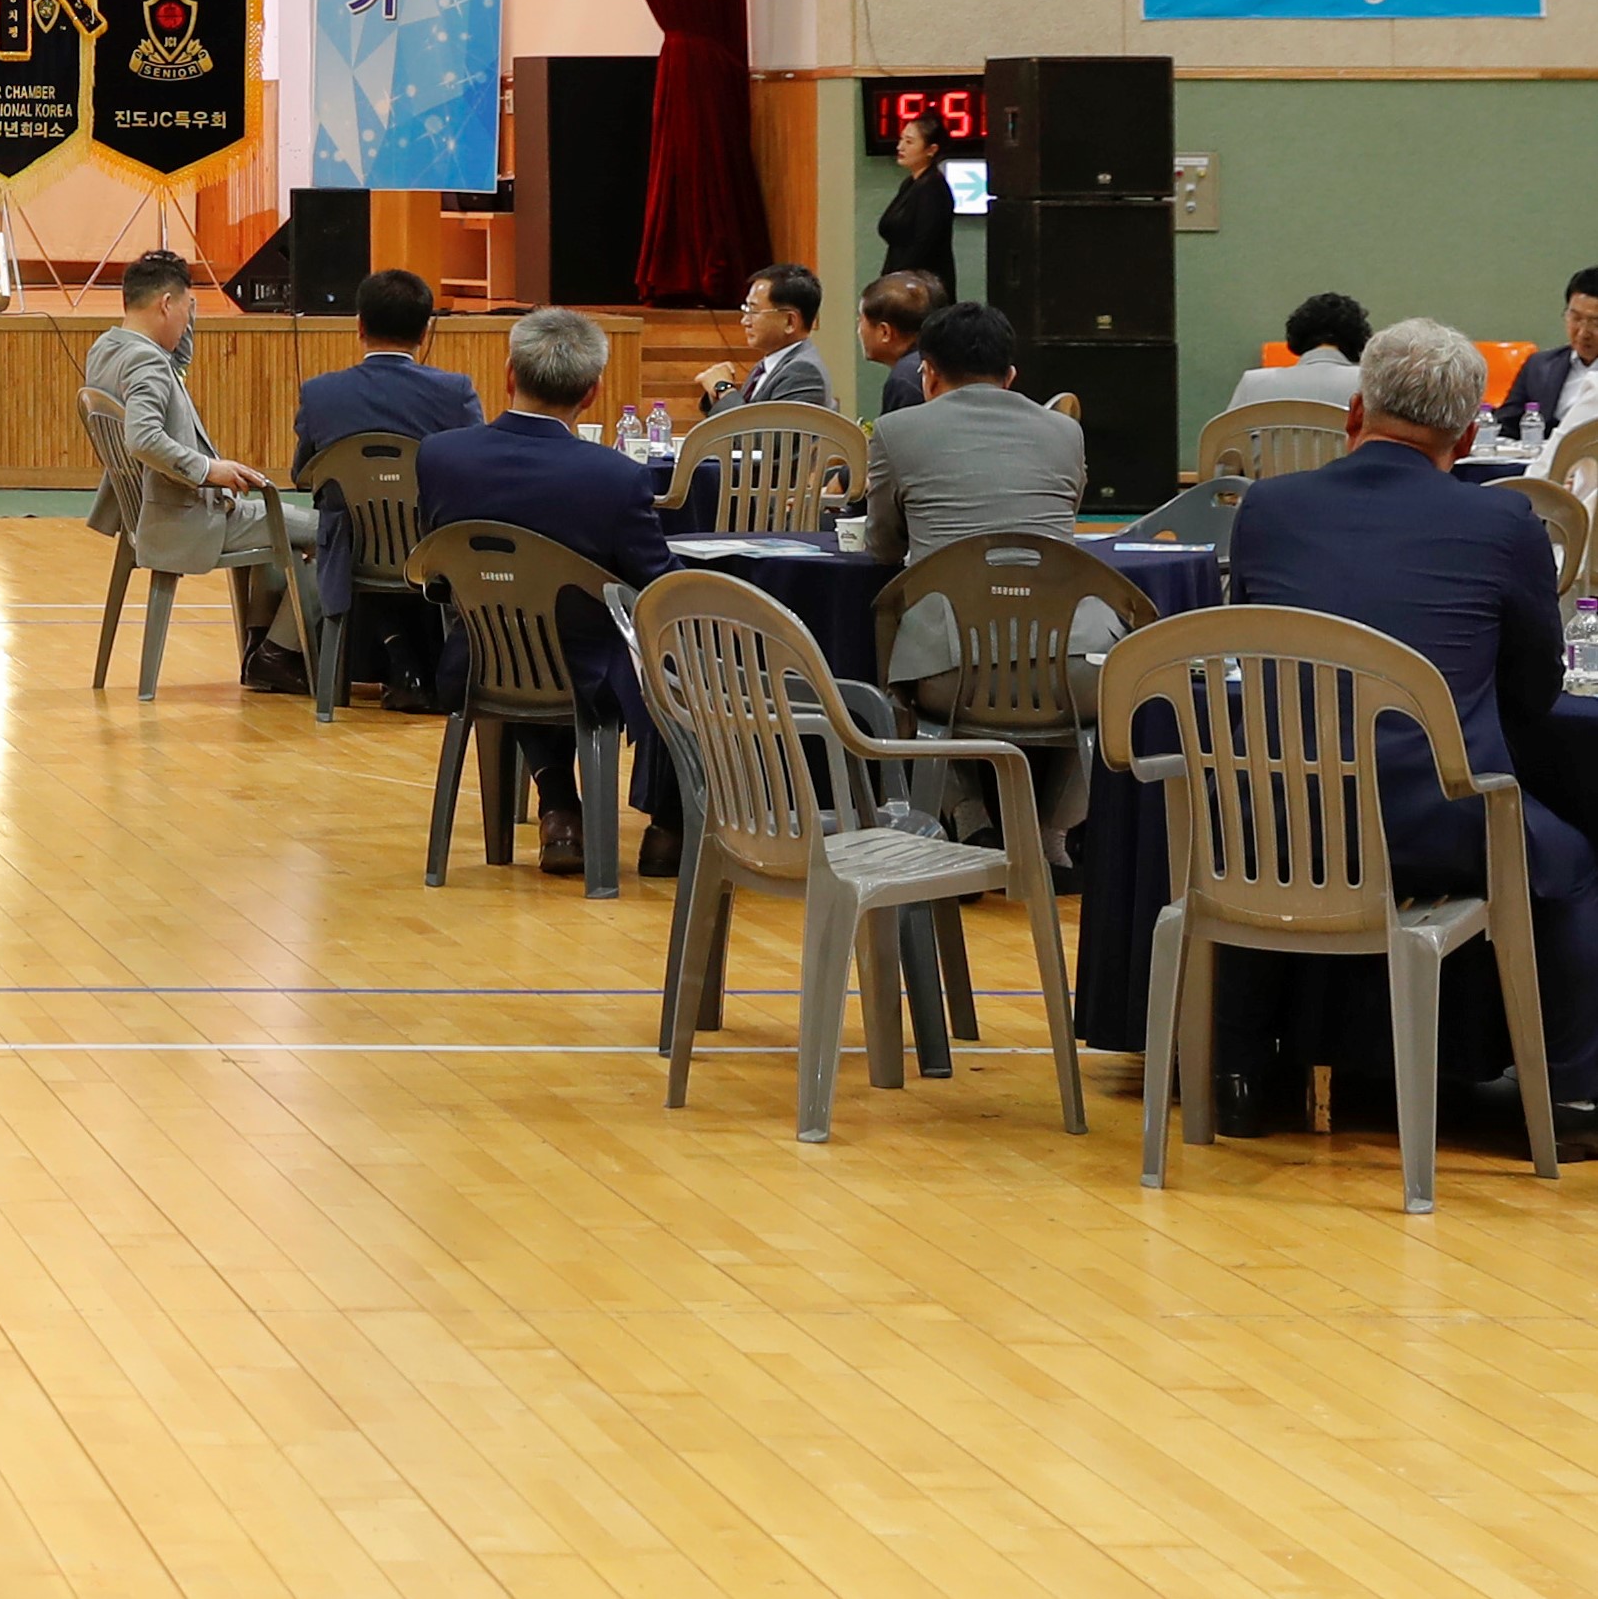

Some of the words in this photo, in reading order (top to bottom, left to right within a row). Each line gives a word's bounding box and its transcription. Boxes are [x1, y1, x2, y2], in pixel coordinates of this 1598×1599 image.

[144, 65, 198, 78] SENIOR
[5, 85, 56, 100] CHAMBER
[35, 103, 73, 118] KOREA
[114, 109, 227, 129] 진도JC특우회
